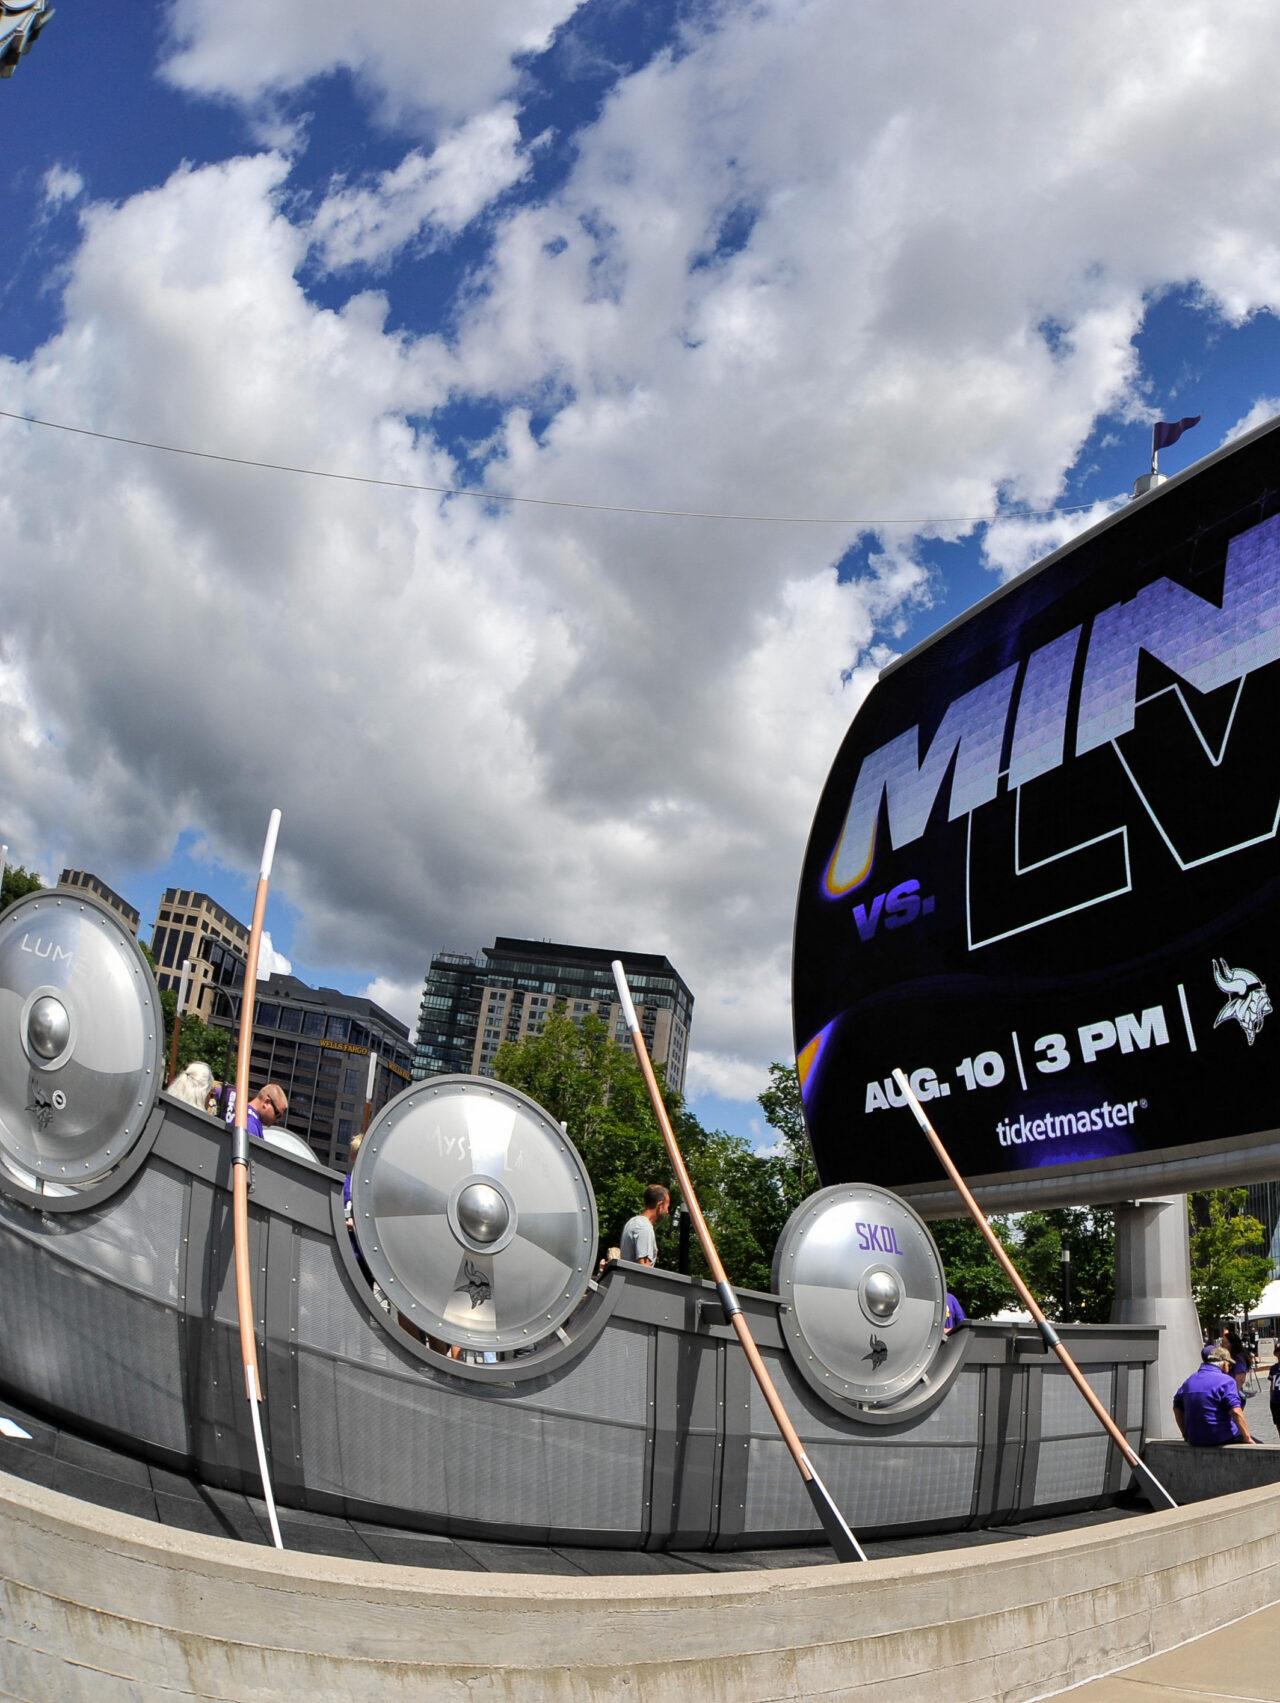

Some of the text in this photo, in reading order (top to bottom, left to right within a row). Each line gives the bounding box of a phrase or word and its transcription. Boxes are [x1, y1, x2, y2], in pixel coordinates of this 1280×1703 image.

[320, 1039, 369, 1055] WELLS FARGO
[864, 1005, 1169, 1114] AUG. 10 3 PM
[855, 1222, 904, 1256] SKOL
